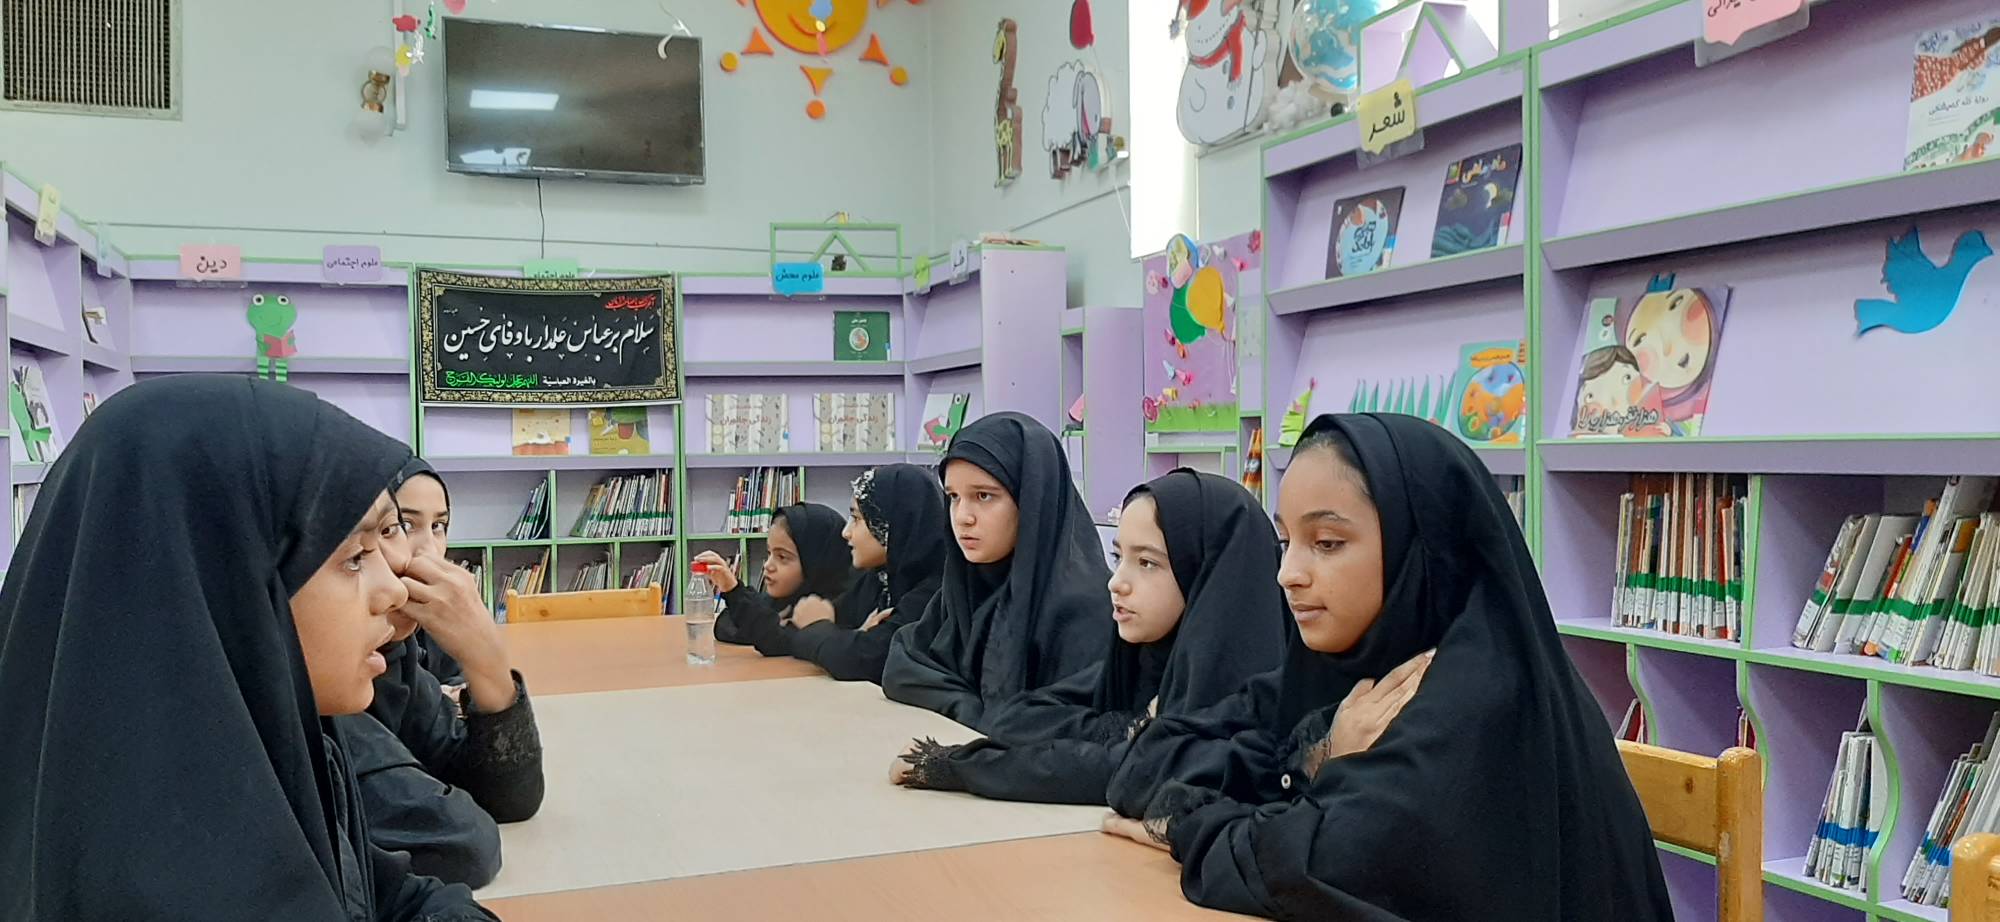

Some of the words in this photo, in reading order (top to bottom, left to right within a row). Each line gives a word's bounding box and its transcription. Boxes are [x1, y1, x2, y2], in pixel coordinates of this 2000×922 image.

[1368, 91, 1406, 143] شعر
[196, 255, 228, 273] دین
[326, 257, 359, 269] اجتماعی
[360, 257, 378, 269] علوم
[775, 268, 799, 282] محض
[801, 269, 819, 282] علوم
[443, 313, 491, 361] حسین
[531, 316, 567, 352] علمدار
[566, 317, 613, 361] عباس
[604, 322, 620, 353] بر
[619, 316, 655, 365] سلام
